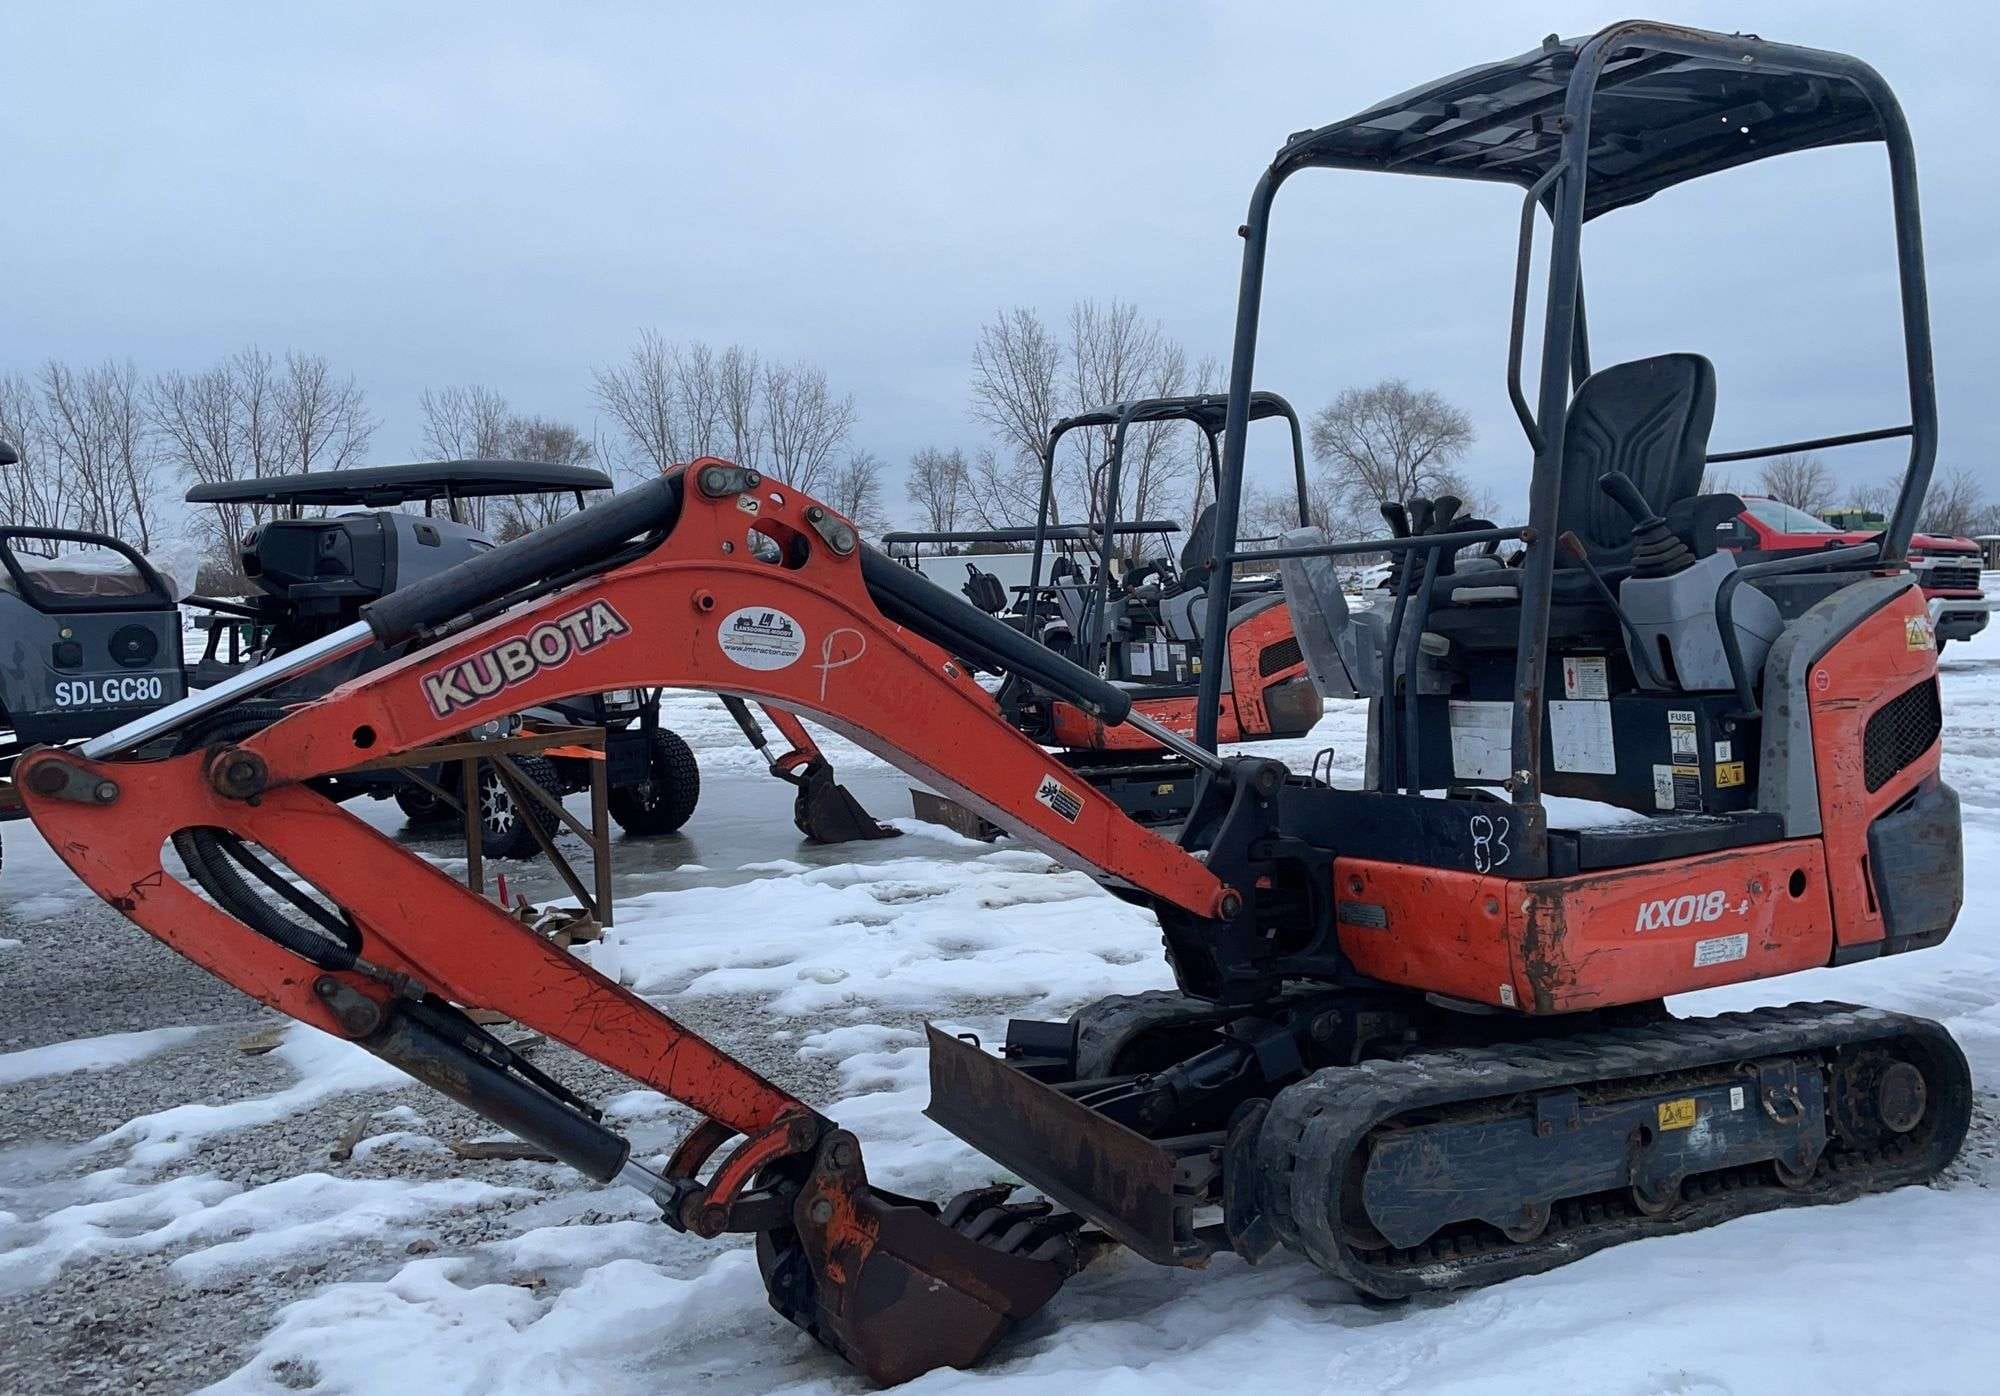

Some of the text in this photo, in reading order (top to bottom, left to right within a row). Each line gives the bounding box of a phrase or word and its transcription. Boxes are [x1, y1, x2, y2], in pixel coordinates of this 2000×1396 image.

[422, 599, 629, 717] KUBOTA
[55, 677, 161, 706] SDLGC80
[1670, 713, 1693, 721] FUSE
